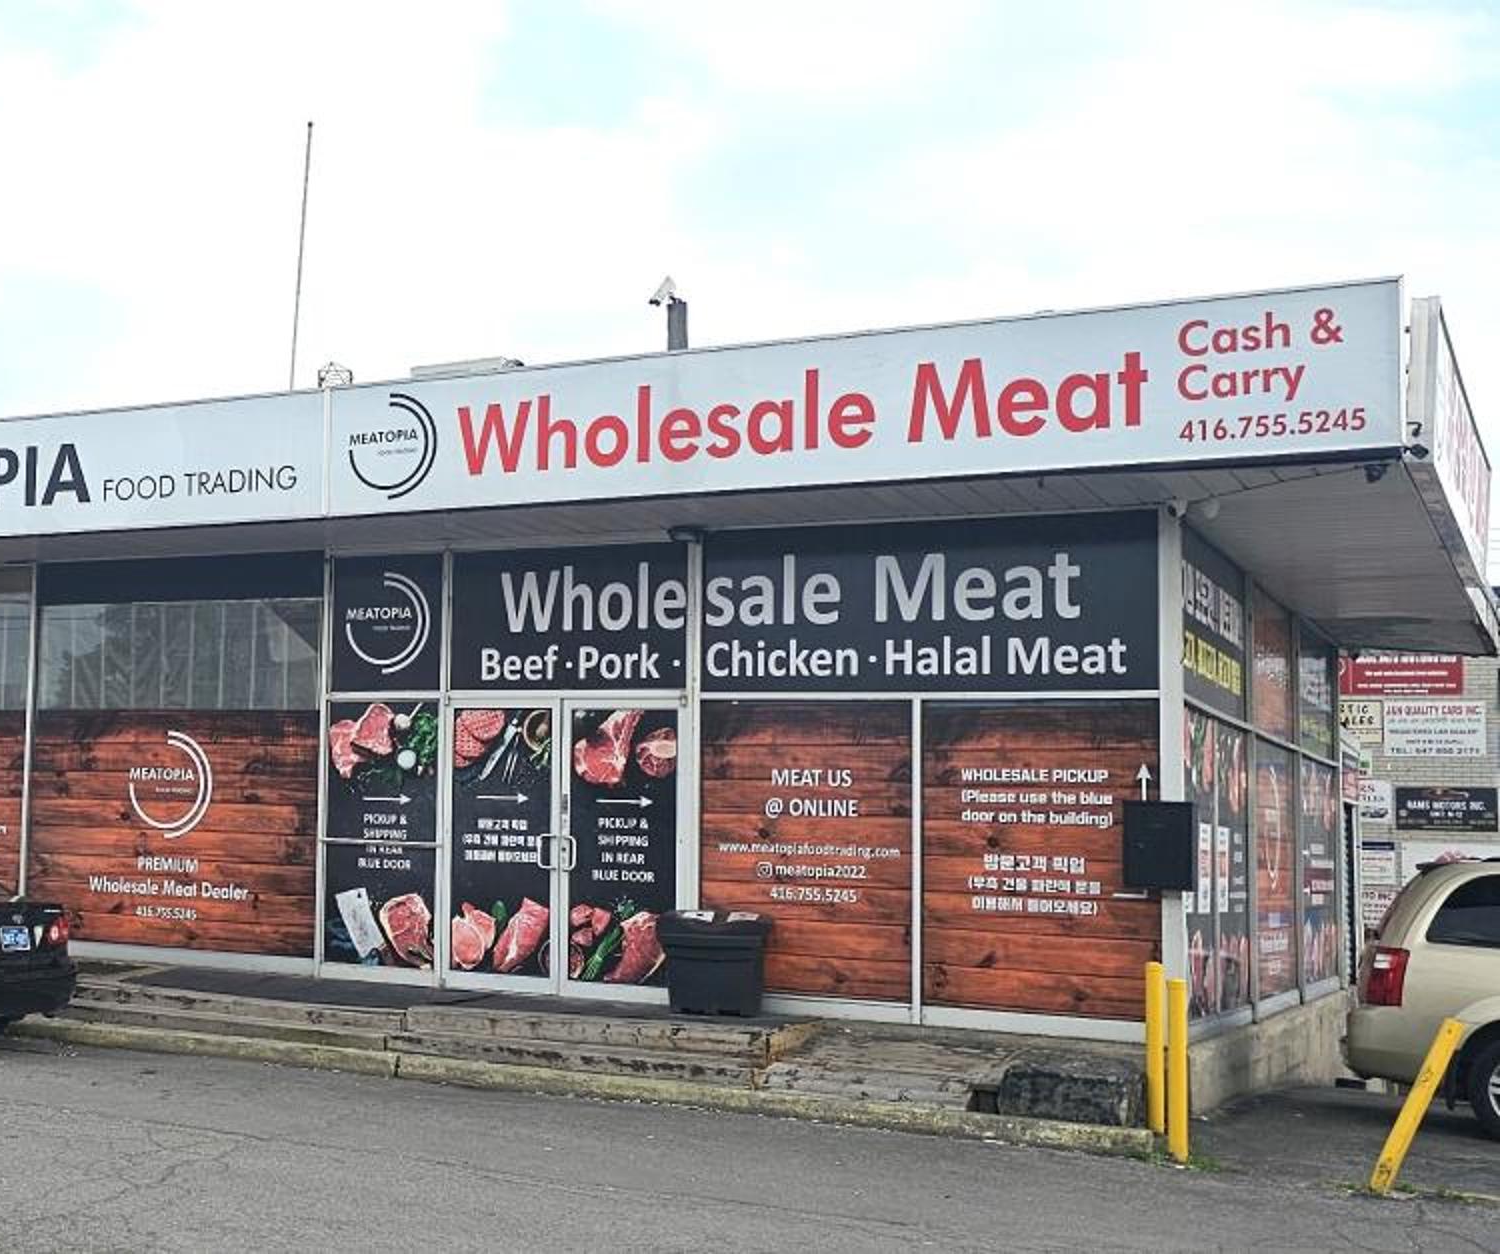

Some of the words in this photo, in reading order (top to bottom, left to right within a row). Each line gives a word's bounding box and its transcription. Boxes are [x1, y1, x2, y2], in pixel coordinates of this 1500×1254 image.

[1178, 312, 1293, 358] Cash
[1309, 307, 1343, 345] &
[1177, 362, 1307, 405] Carry
[457, 369, 878, 477] Wholesale
[905, 351, 1150, 444] Meat
[1178, 406, 1367, 443] 416.755.5245
[347, 427, 420, 449] MEATOPIA
[102, 474, 176, 503] FOOD
[183, 464, 299, 496] TRADING
[873, 552, 1083, 626] Meat
[345, 606, 413, 622] MEATOPIA
[480, 645, 560, 682] Beef
[578, 643, 661, 680] Pork
[705, 636, 860, 679] Chicken
[885, 636, 993, 677] Halal
[1005, 635, 1128, 677] Meat
[1404, 705, 1439, 716] QUALITY
[129, 767, 195, 782] MEATOPIA
[771, 768, 824, 788] MEAT
[828, 769, 852, 788] US
[961, 768, 1050, 784] WHOLESALE
[1052, 768, 1110, 784] PICKUP
[960, 788, 1016, 805] (Please
[1019, 792, 1048, 805] use
[1051, 790, 1076, 806] the
[1079, 791, 1113, 806] blue
[765, 799, 784, 819] @
[788, 798, 859, 818] ONLINE
[363, 813, 397, 825] PICKUP
[597, 817, 637, 830] PICKUP
[961, 808, 995, 823] door
[998, 812, 1018, 824] on
[1021, 810, 1045, 824] the
[1049, 810, 1114, 828] building)
[363, 828, 407, 841] SHIPPING
[597, 835, 649, 847] SHIPPING
[601, 852, 613, 864] IN
[615, 852, 645, 865] REAR
[718, 841, 900, 860] www.meatopiafoodtrading.com
[136, 856, 199, 873] PREMIUM
[357, 857, 381, 869] BLUE
[382, 858, 412, 870] DOOR
[775, 863, 867, 881] meatopia2022
[592, 869, 619, 882] BLUE
[621, 870, 655, 883] DOOR
[89, 875, 159, 896] Wholesale
[163, 879, 198, 898] Meat
[201, 880, 250, 901] Dealer
[769, 887, 858, 904] 416.755.5245
